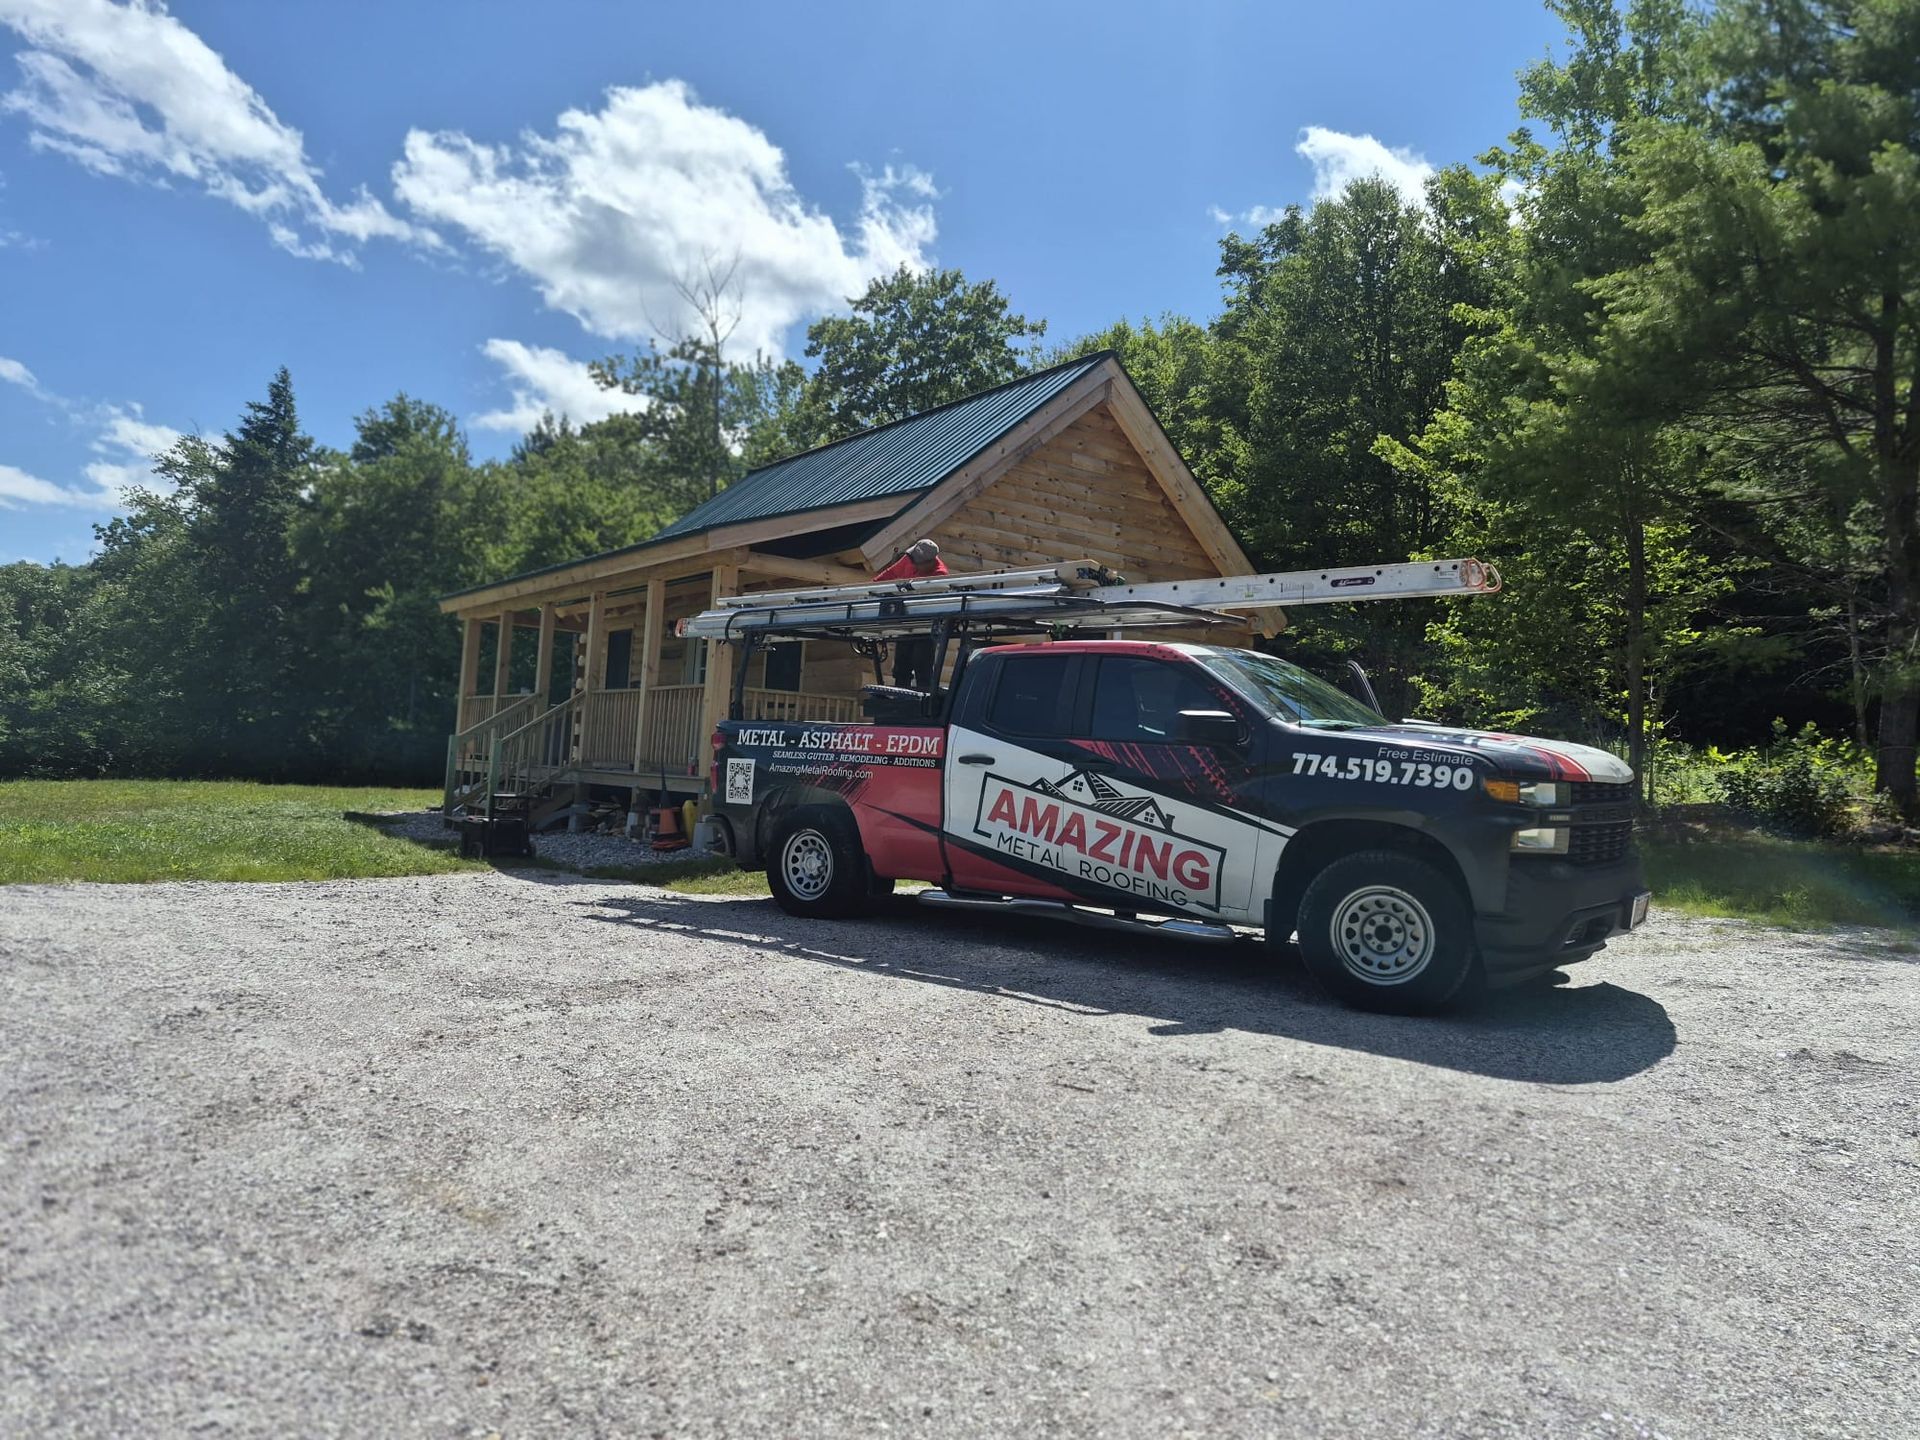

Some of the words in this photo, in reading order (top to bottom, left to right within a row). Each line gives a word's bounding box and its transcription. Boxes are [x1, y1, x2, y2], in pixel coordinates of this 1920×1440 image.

[737, 729, 786, 747] METAL
[798, 731, 873, 751] ASPHALT
[886, 734, 940, 755] EPDM
[772, 750, 806, 760] SEAMLESS
[807, 752, 835, 761] GUTTER
[839, 754, 888, 765] REMODELING
[893, 758, 936, 768] ADDITIONS
[1377, 747, 1408, 760] Free
[1412, 750, 1474, 766] Estimate
[769, 763, 873, 780] AmazingMetalRoofing.com
[1292, 753, 1474, 791] 774.519.7390
[987, 789, 1210, 890] AMAZING
[997, 833, 1069, 872] METAL
[1079, 860, 1188, 906] ROOFING
